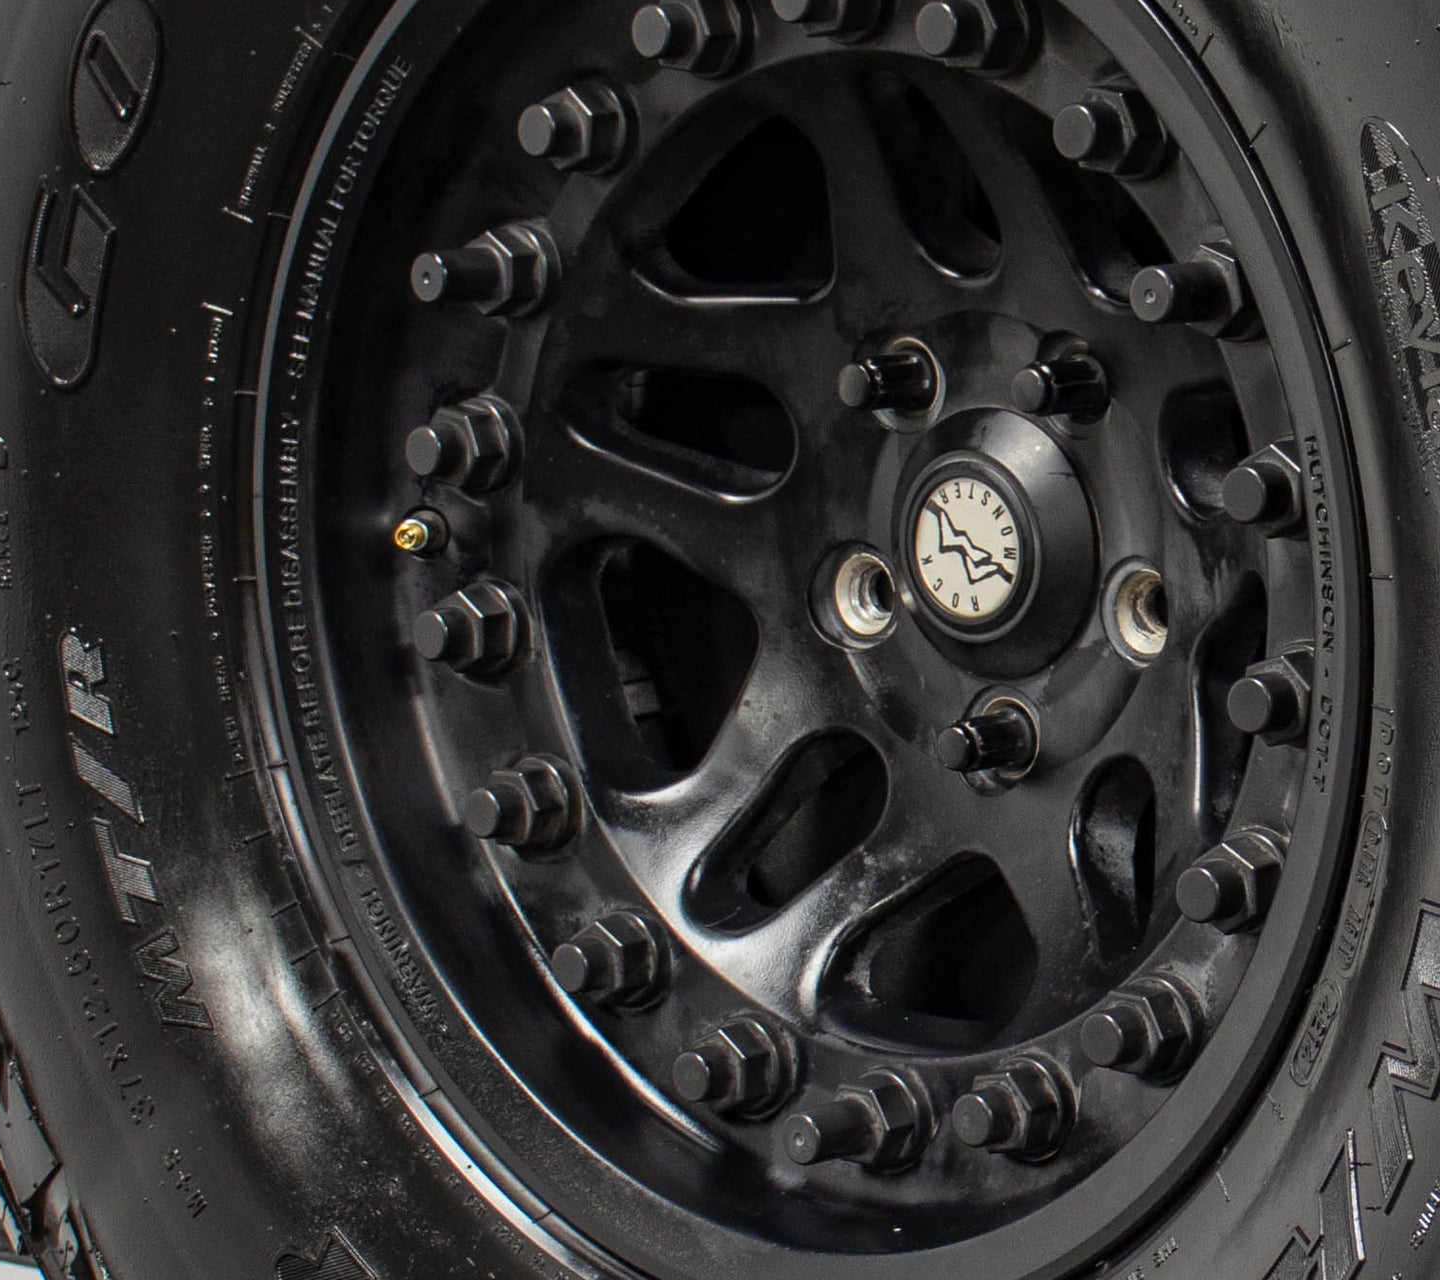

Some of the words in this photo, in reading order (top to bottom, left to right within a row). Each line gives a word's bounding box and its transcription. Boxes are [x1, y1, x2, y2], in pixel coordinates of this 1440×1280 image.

[920, 552, 980, 611] ROCK
[937, 481, 1017, 560] MONSTER
[1301, 432, 1337, 656] HUTCHINSON
[58, 626, 213, 1033] MT/R
